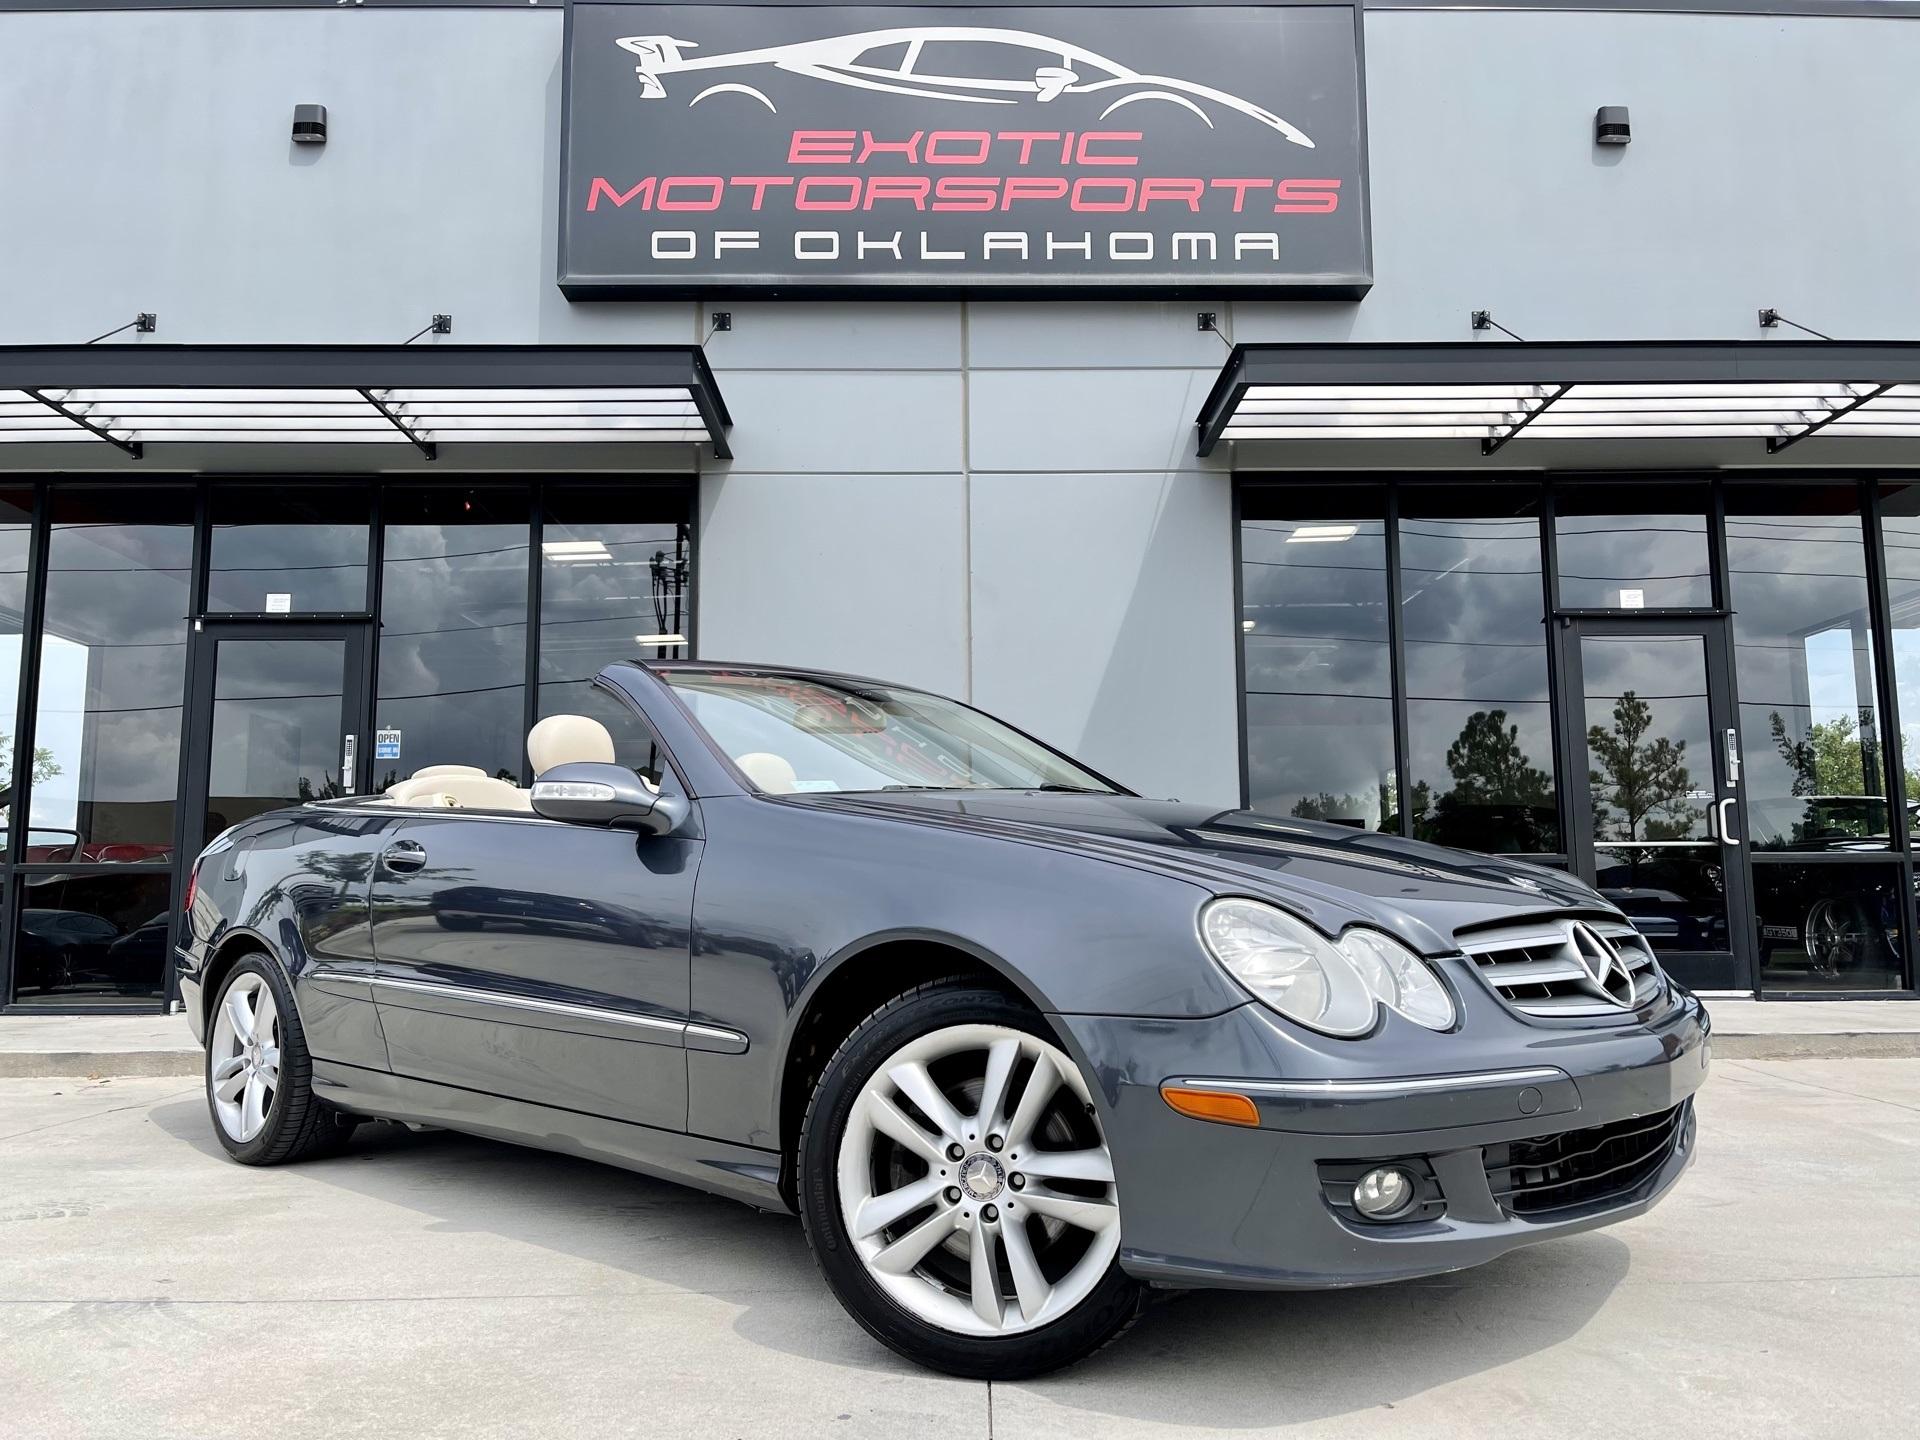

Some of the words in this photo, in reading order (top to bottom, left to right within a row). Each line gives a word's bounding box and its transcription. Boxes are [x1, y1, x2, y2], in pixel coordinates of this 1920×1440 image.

[788, 129, 1142, 166] EXOTIC
[587, 175, 1341, 214] MOTORSPORTS
[650, 230, 760, 260] OF
[794, 231, 1280, 261] OKLAHOMA
[377, 733, 400, 743] OPEN
